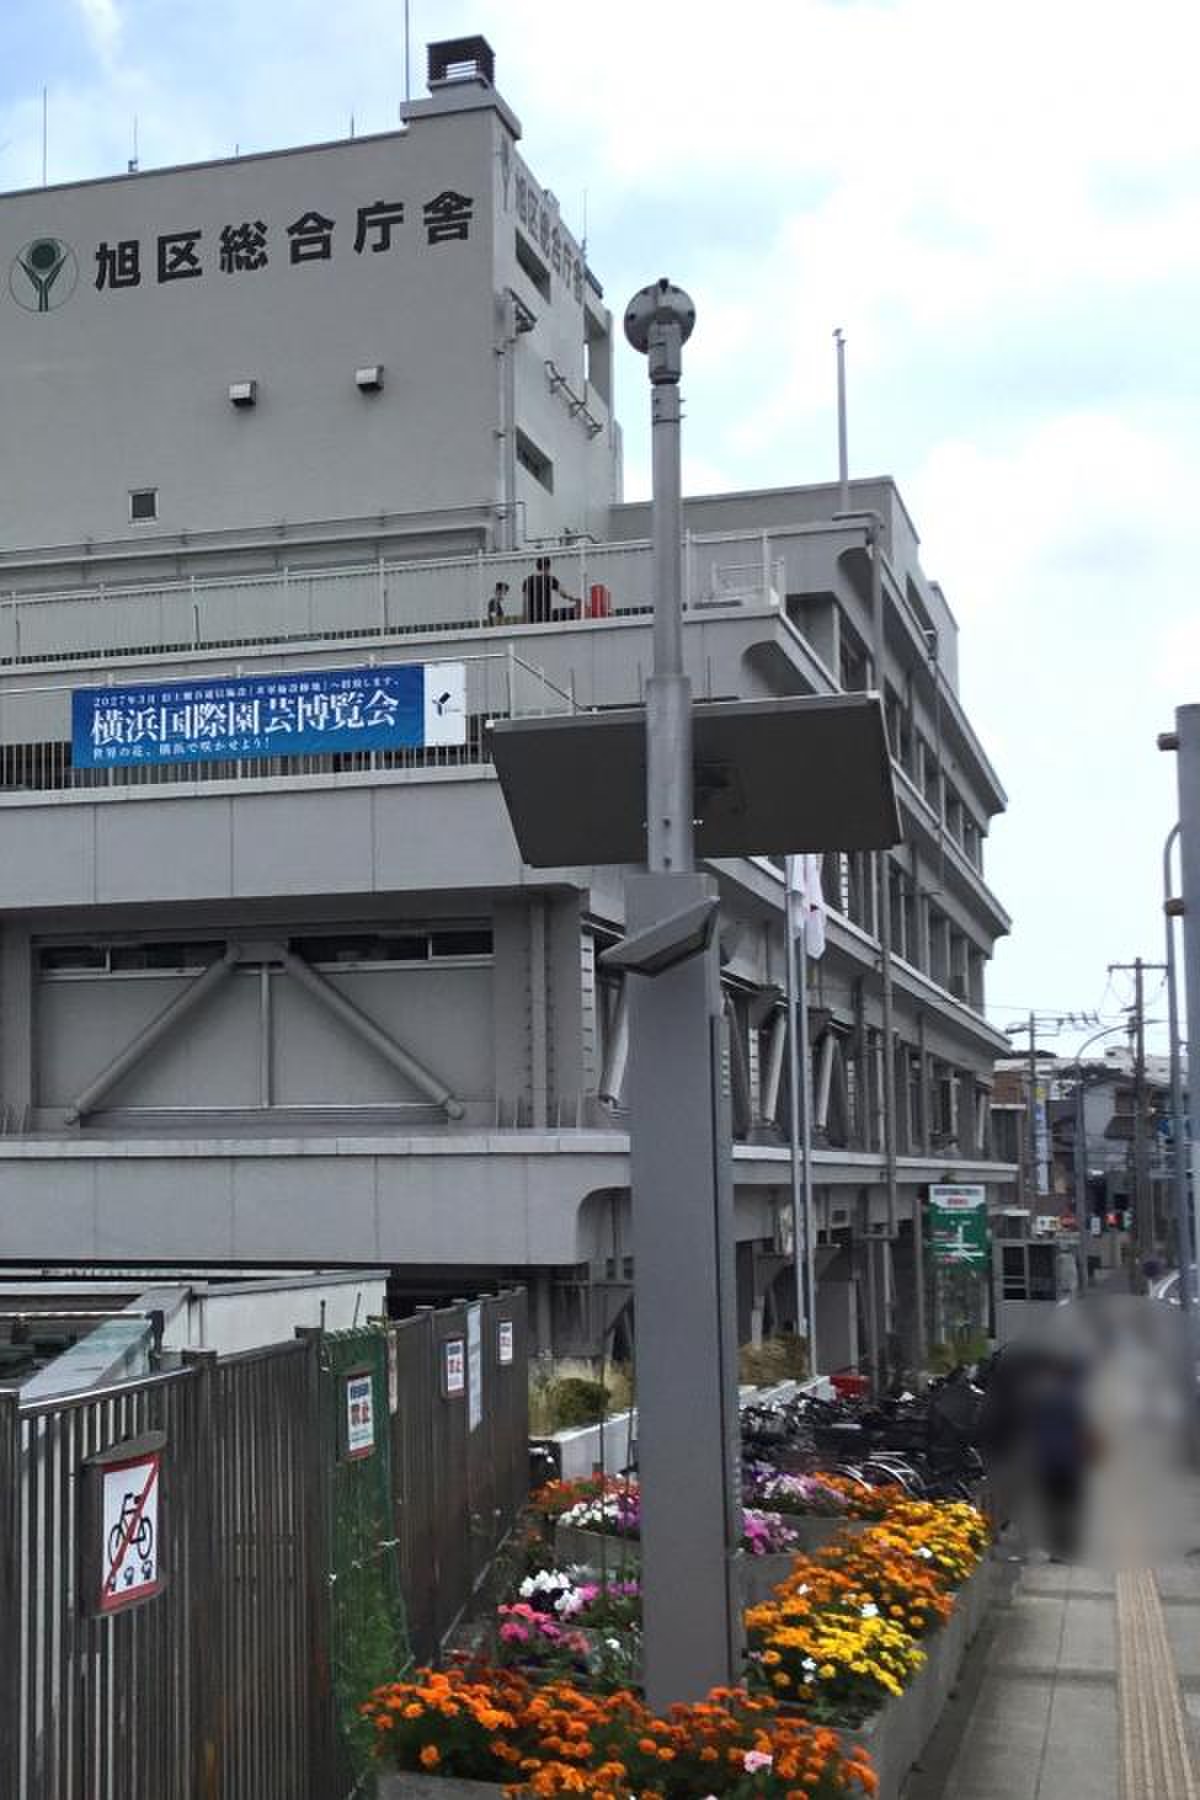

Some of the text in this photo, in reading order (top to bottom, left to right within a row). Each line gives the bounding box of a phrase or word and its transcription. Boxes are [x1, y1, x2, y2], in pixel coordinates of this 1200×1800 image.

[94, 190, 474, 291] 旭区総合庁舎
[89, 688, 399, 745] 横浜国際園芸博覧会
